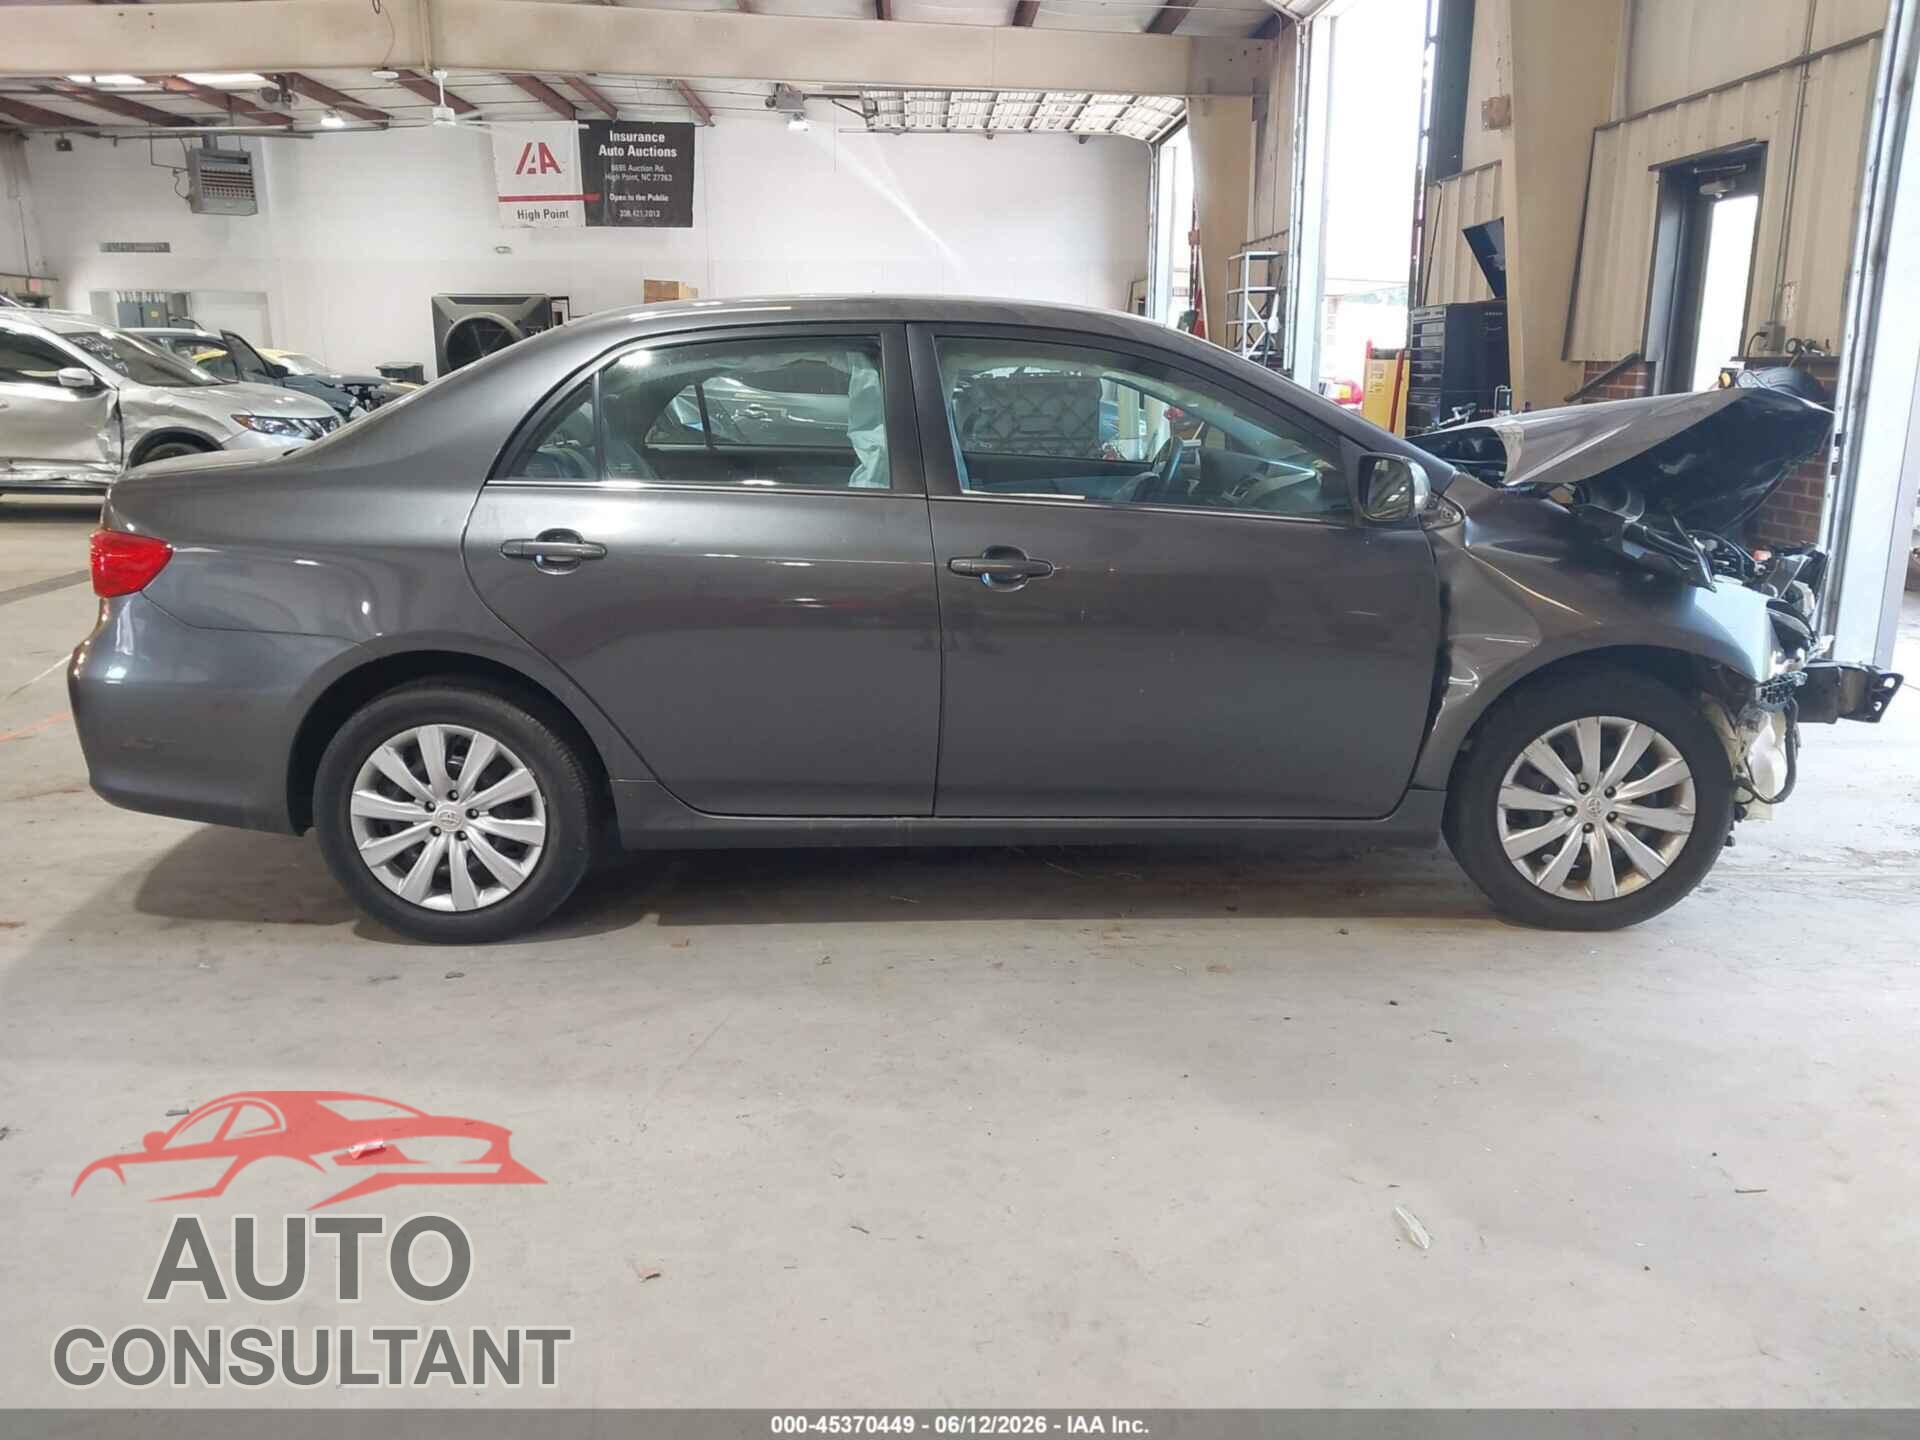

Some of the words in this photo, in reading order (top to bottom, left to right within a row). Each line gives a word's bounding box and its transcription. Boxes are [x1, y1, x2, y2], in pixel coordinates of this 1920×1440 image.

[609, 130, 666, 143] Insurance
[598, 144, 625, 156] Auto
[627, 145, 678, 158] Auctions
[628, 164, 653, 172] Auction
[604, 172, 621, 183] High
[641, 173, 651, 181] NC
[609, 193, 627, 203] Open
[635, 193, 647, 201] the
[647, 193, 669, 202] Public
[516, 209, 540, 221] High
[543, 208, 569, 220] Point
